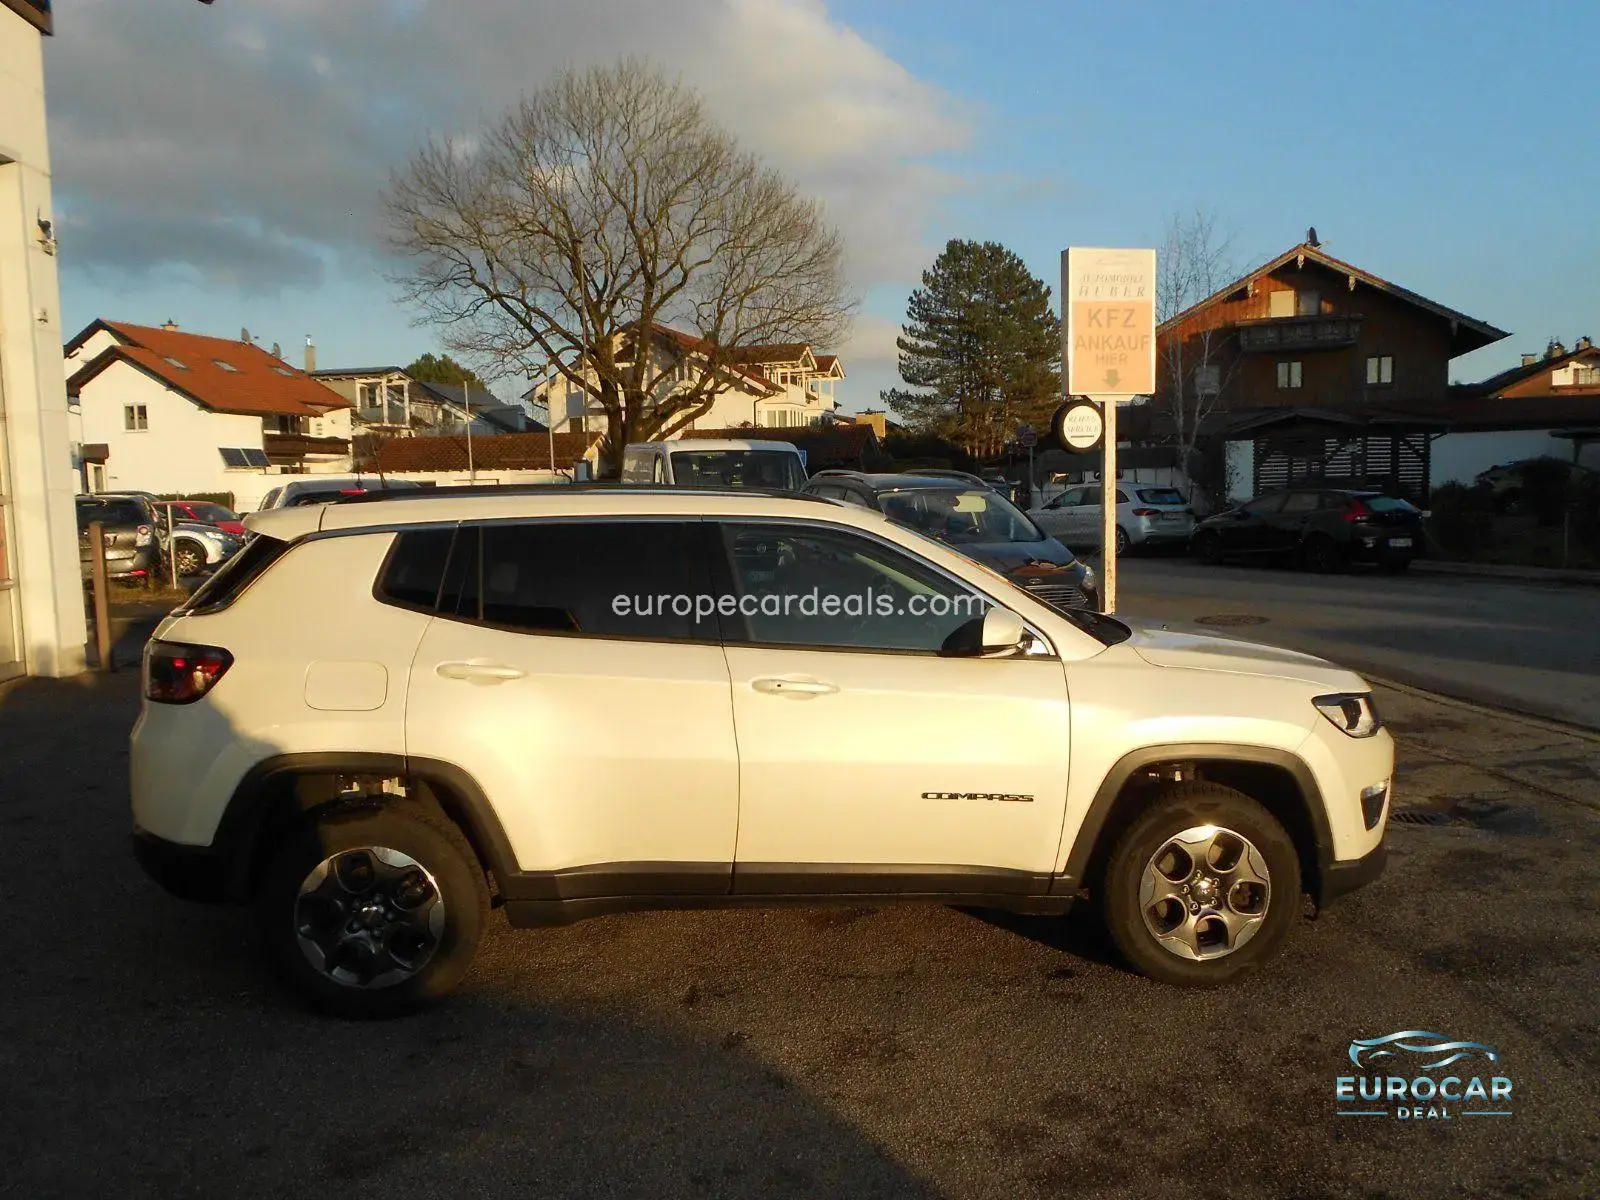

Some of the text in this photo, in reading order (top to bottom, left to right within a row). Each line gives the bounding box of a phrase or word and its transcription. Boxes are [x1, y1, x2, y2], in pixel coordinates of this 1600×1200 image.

[1078, 285, 1145, 297] HUBER
[1087, 308, 1137, 329] KFZ
[1075, 334, 1150, 352] ANKAUF
[1096, 353, 1129, 366] HIER
[921, 792, 1034, 802] COMPASS
